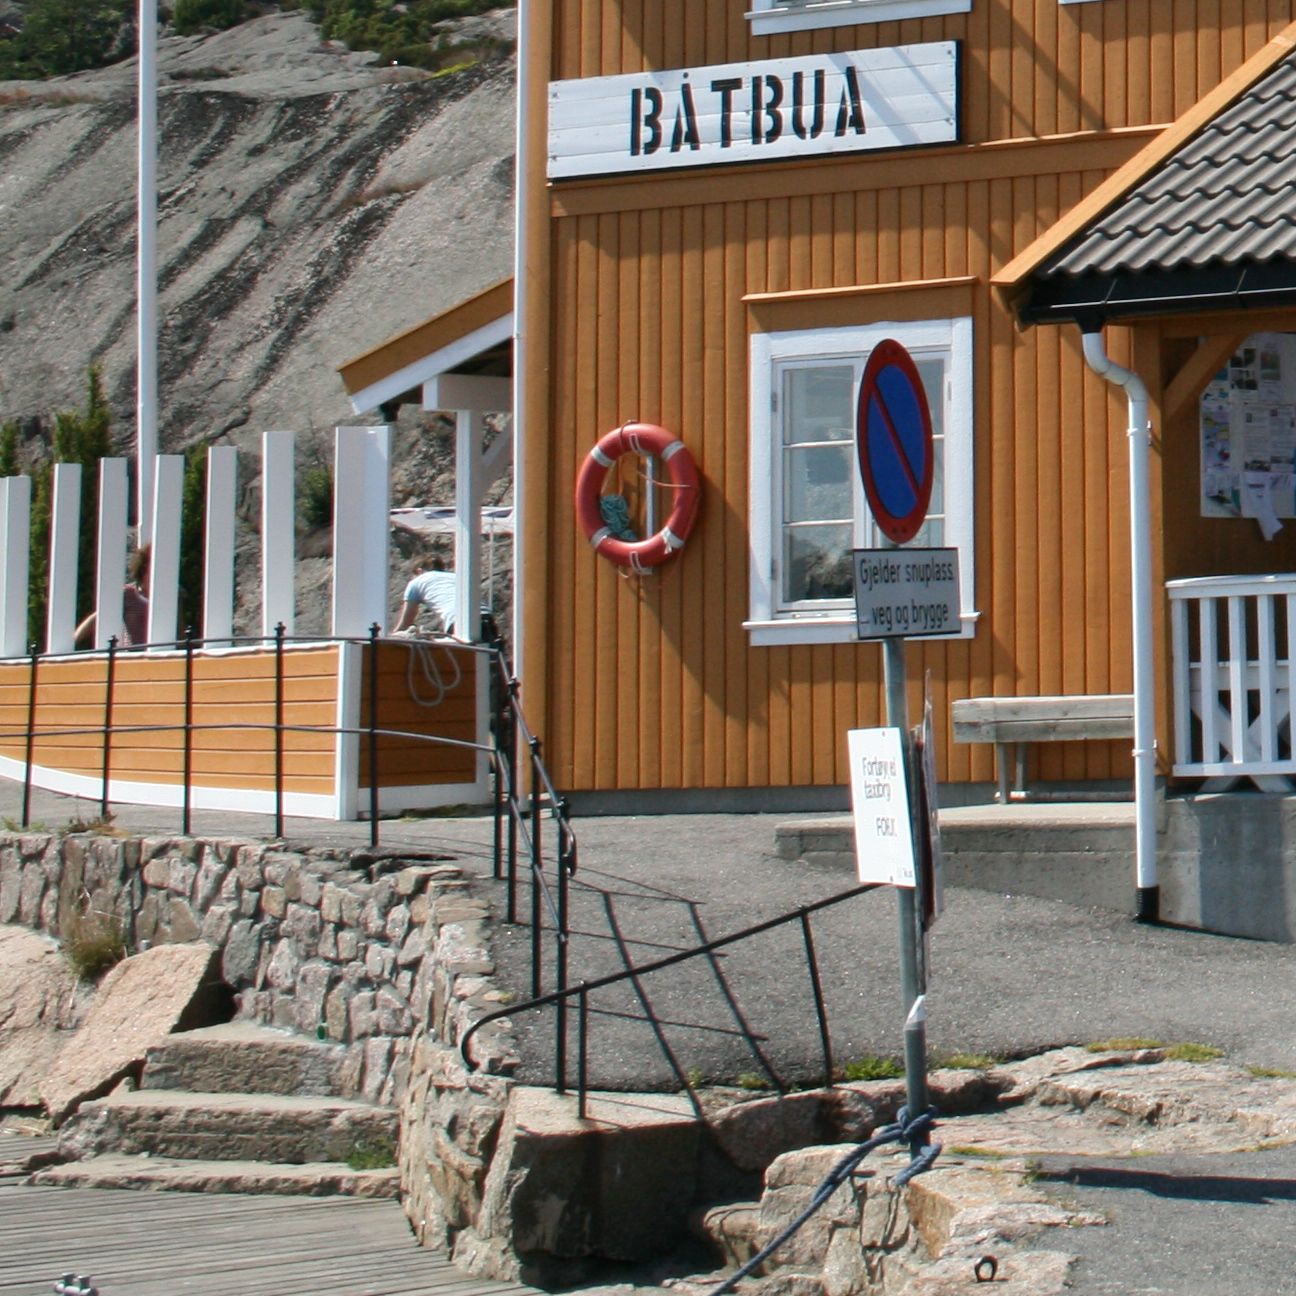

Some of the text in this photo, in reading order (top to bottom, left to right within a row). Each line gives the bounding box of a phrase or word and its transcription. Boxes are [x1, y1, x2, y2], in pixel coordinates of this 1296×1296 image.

[629, 65, 867, 157] BÅTBUA
[859, 557, 954, 591] Gjelder snuplass
[872, 599, 949, 631] veg og brygge
